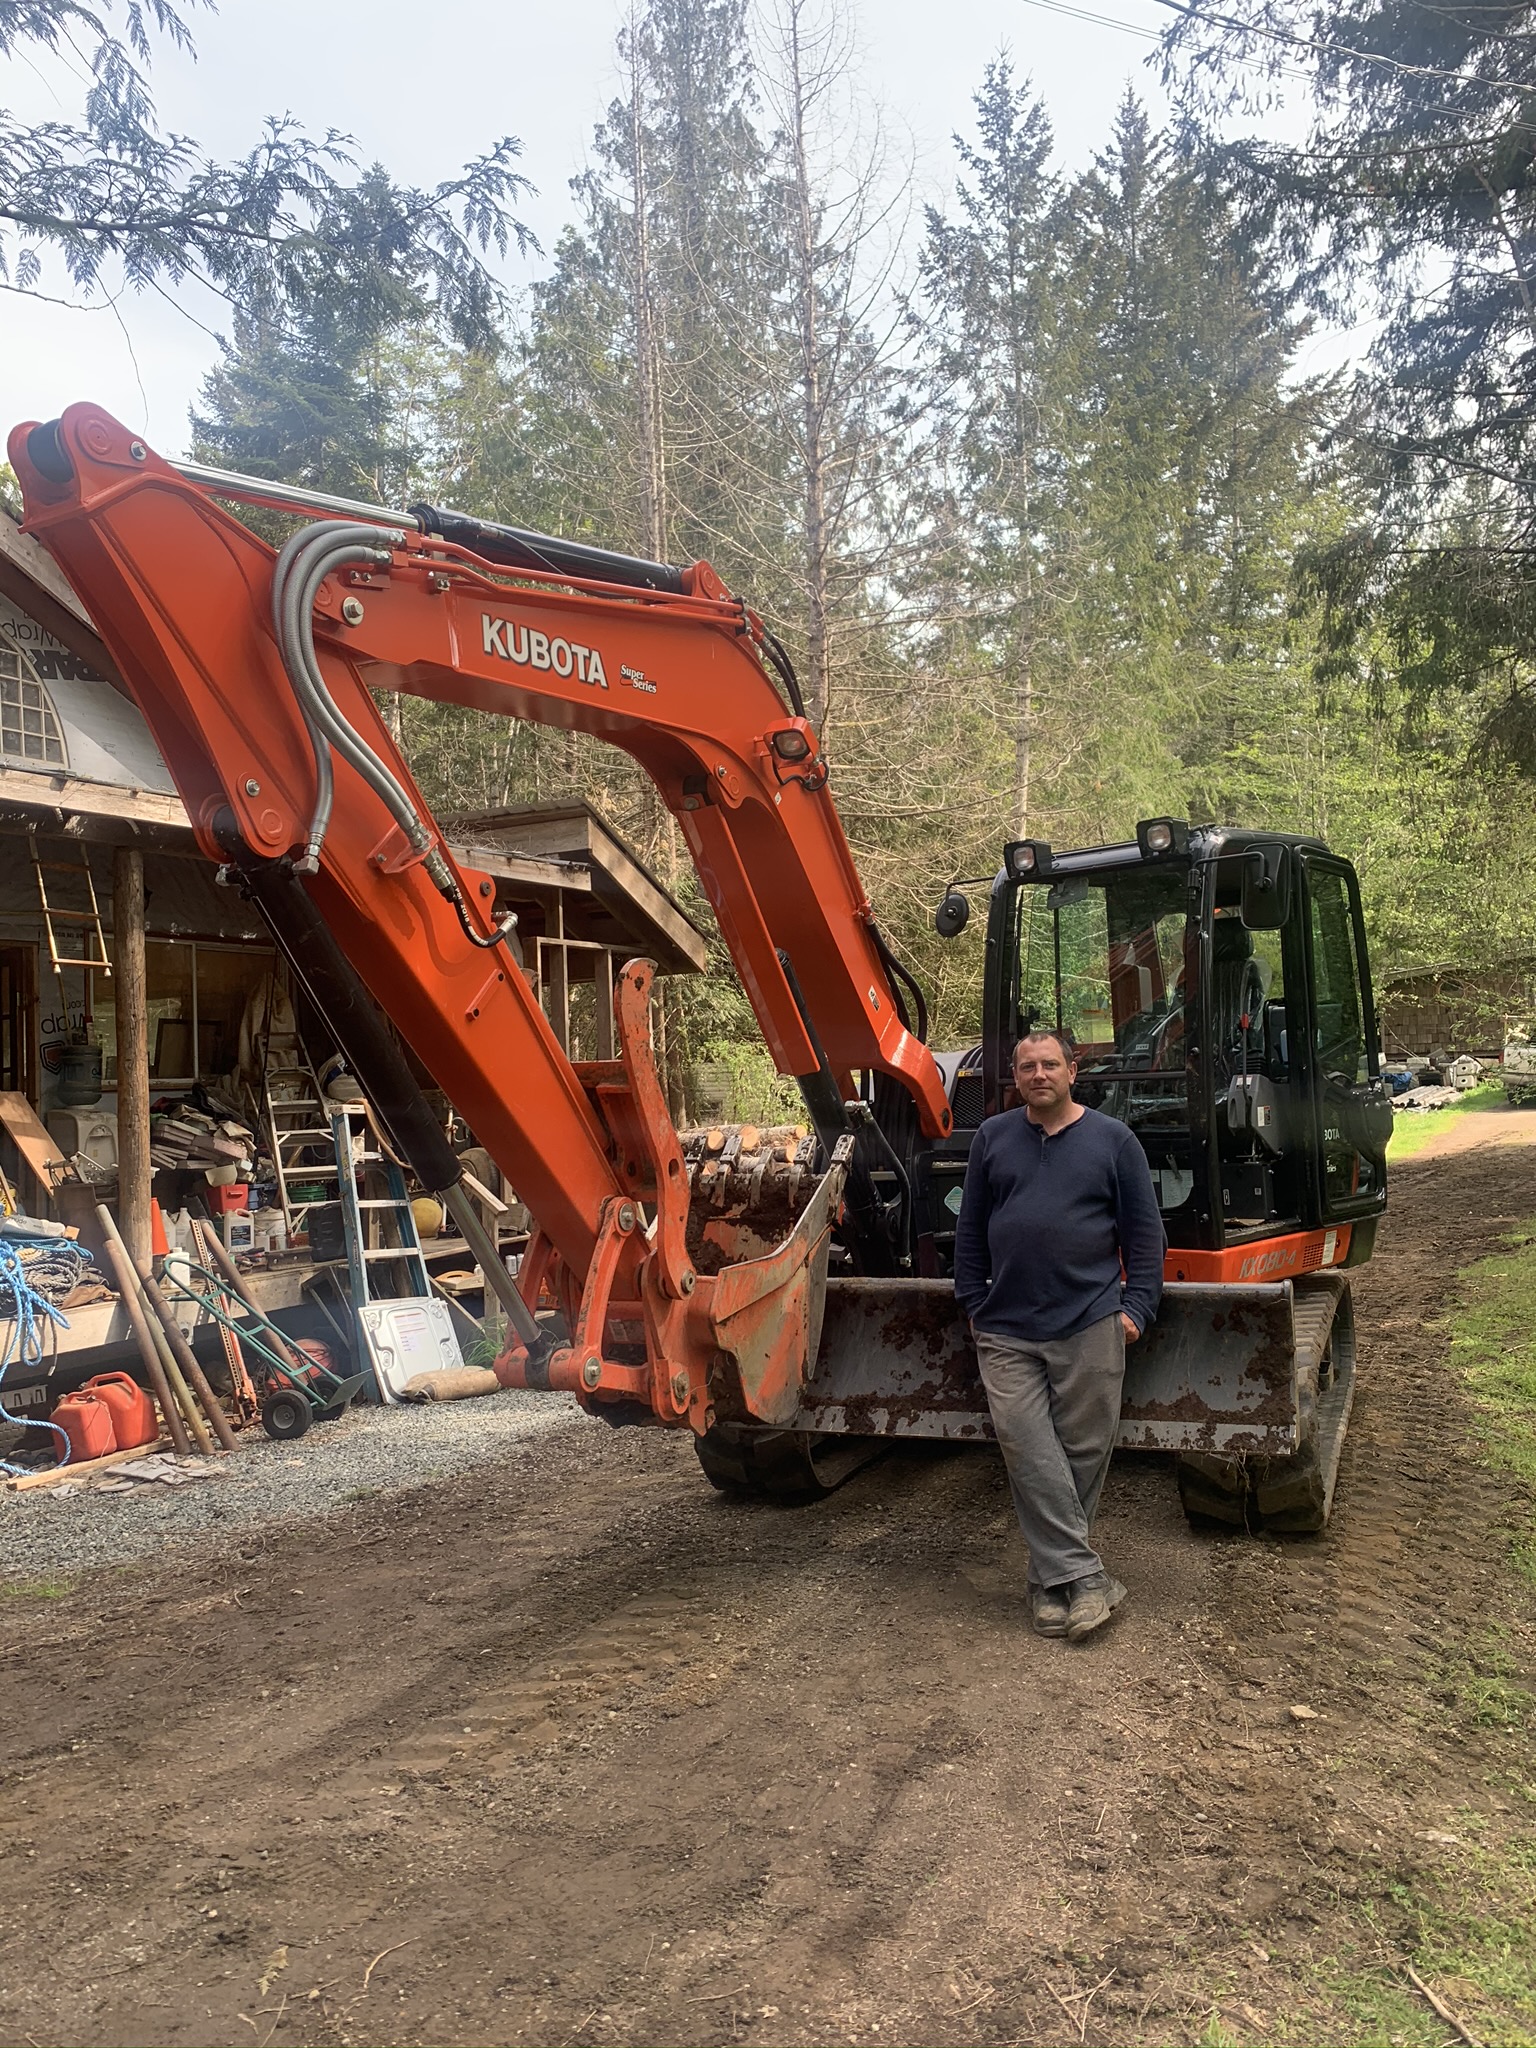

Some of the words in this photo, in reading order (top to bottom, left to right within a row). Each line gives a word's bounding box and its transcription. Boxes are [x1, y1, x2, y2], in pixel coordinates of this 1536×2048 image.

[482, 613, 608, 687] KUBOTA
[620, 663, 645, 680] Super
[632, 677, 657, 694] Series
[62, 999, 85, 1011] .com
[1324, 1128, 1340, 1141] BOTA
[1239, 1249, 1297, 1279] KX080-4
